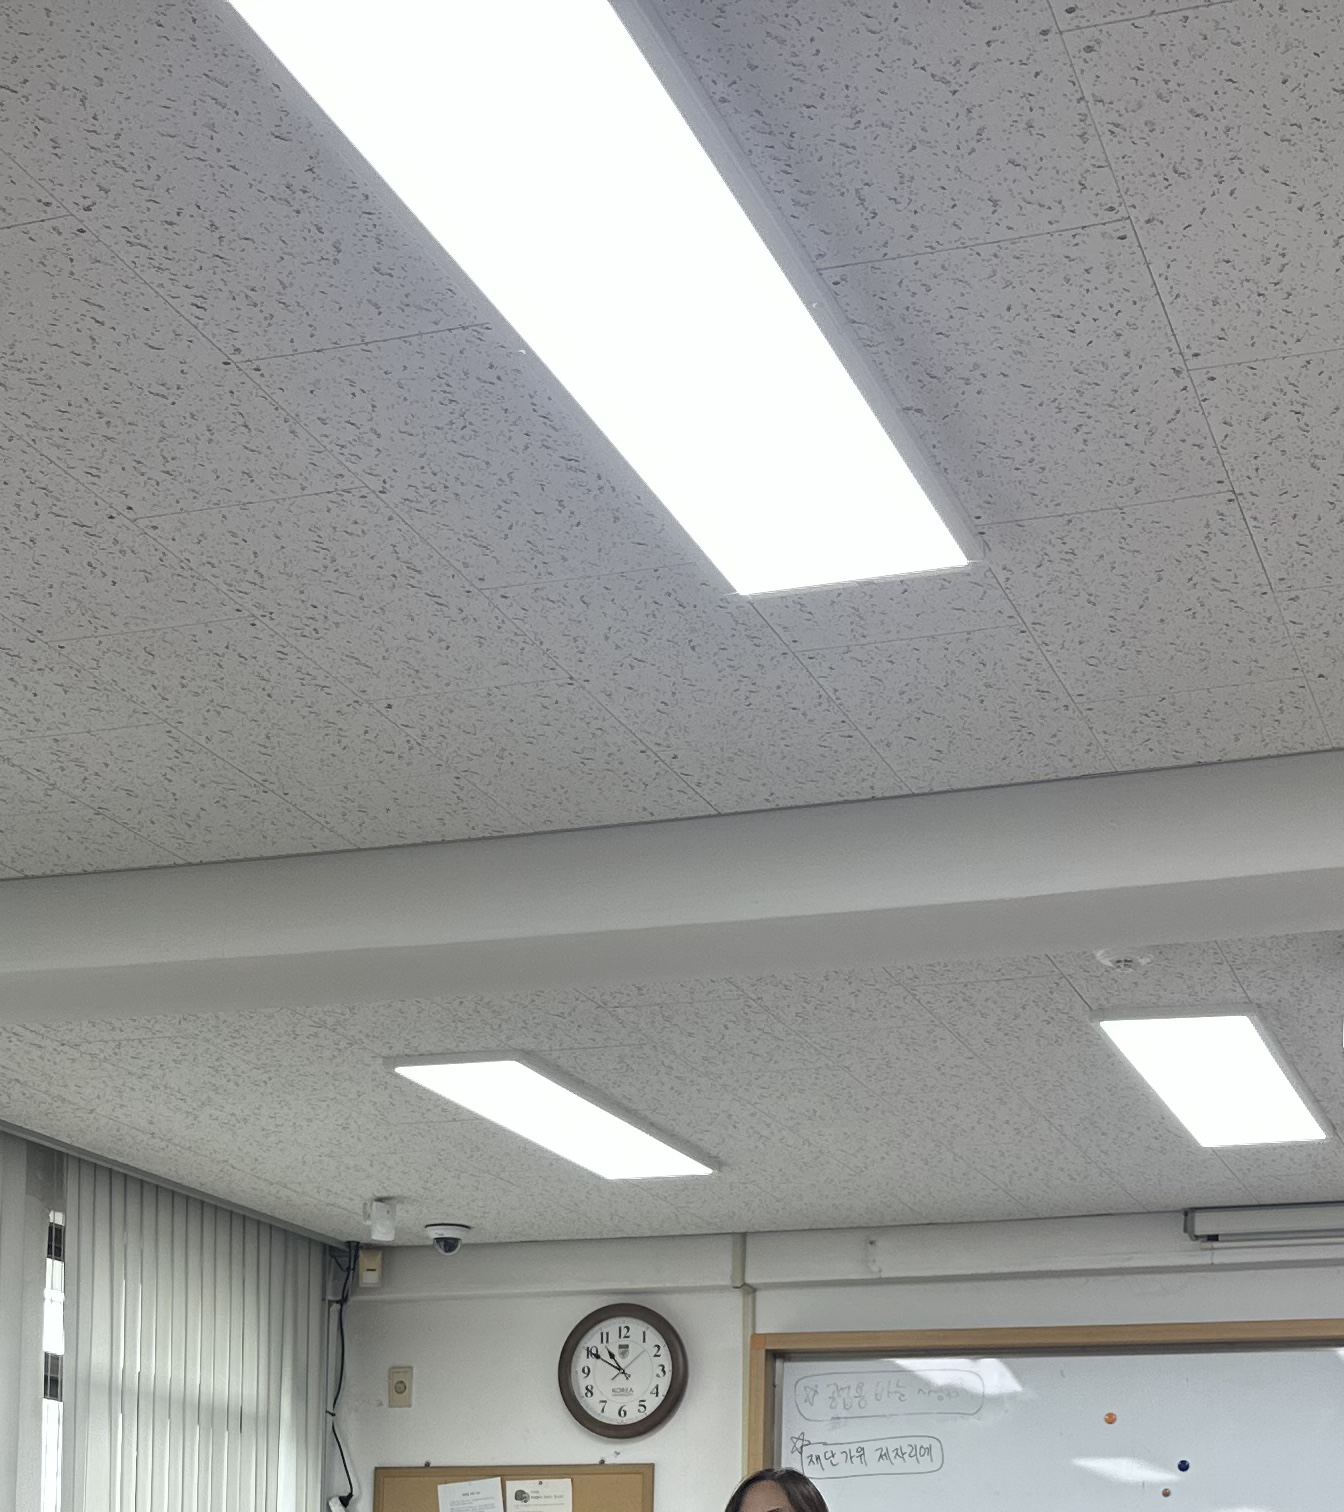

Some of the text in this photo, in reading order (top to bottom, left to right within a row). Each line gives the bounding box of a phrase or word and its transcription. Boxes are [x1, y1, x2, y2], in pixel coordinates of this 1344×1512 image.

[600, 1331, 609, 1344] 11
[618, 1325, 630, 1339] 12
[642, 1330, 646, 1343] 1
[653, 1344, 661, 1358] 2
[581, 1366, 591, 1379] 9
[656, 1364, 666, 1378] 3
[584, 1384, 594, 1398] 8
[650, 1384, 659, 1397] 4
[599, 1400, 607, 1413] 7
[618, 1405, 627, 1418] 6
[637, 1400, 647, 1413] 5
[875, 1443, 934, 1467] 제자리에
